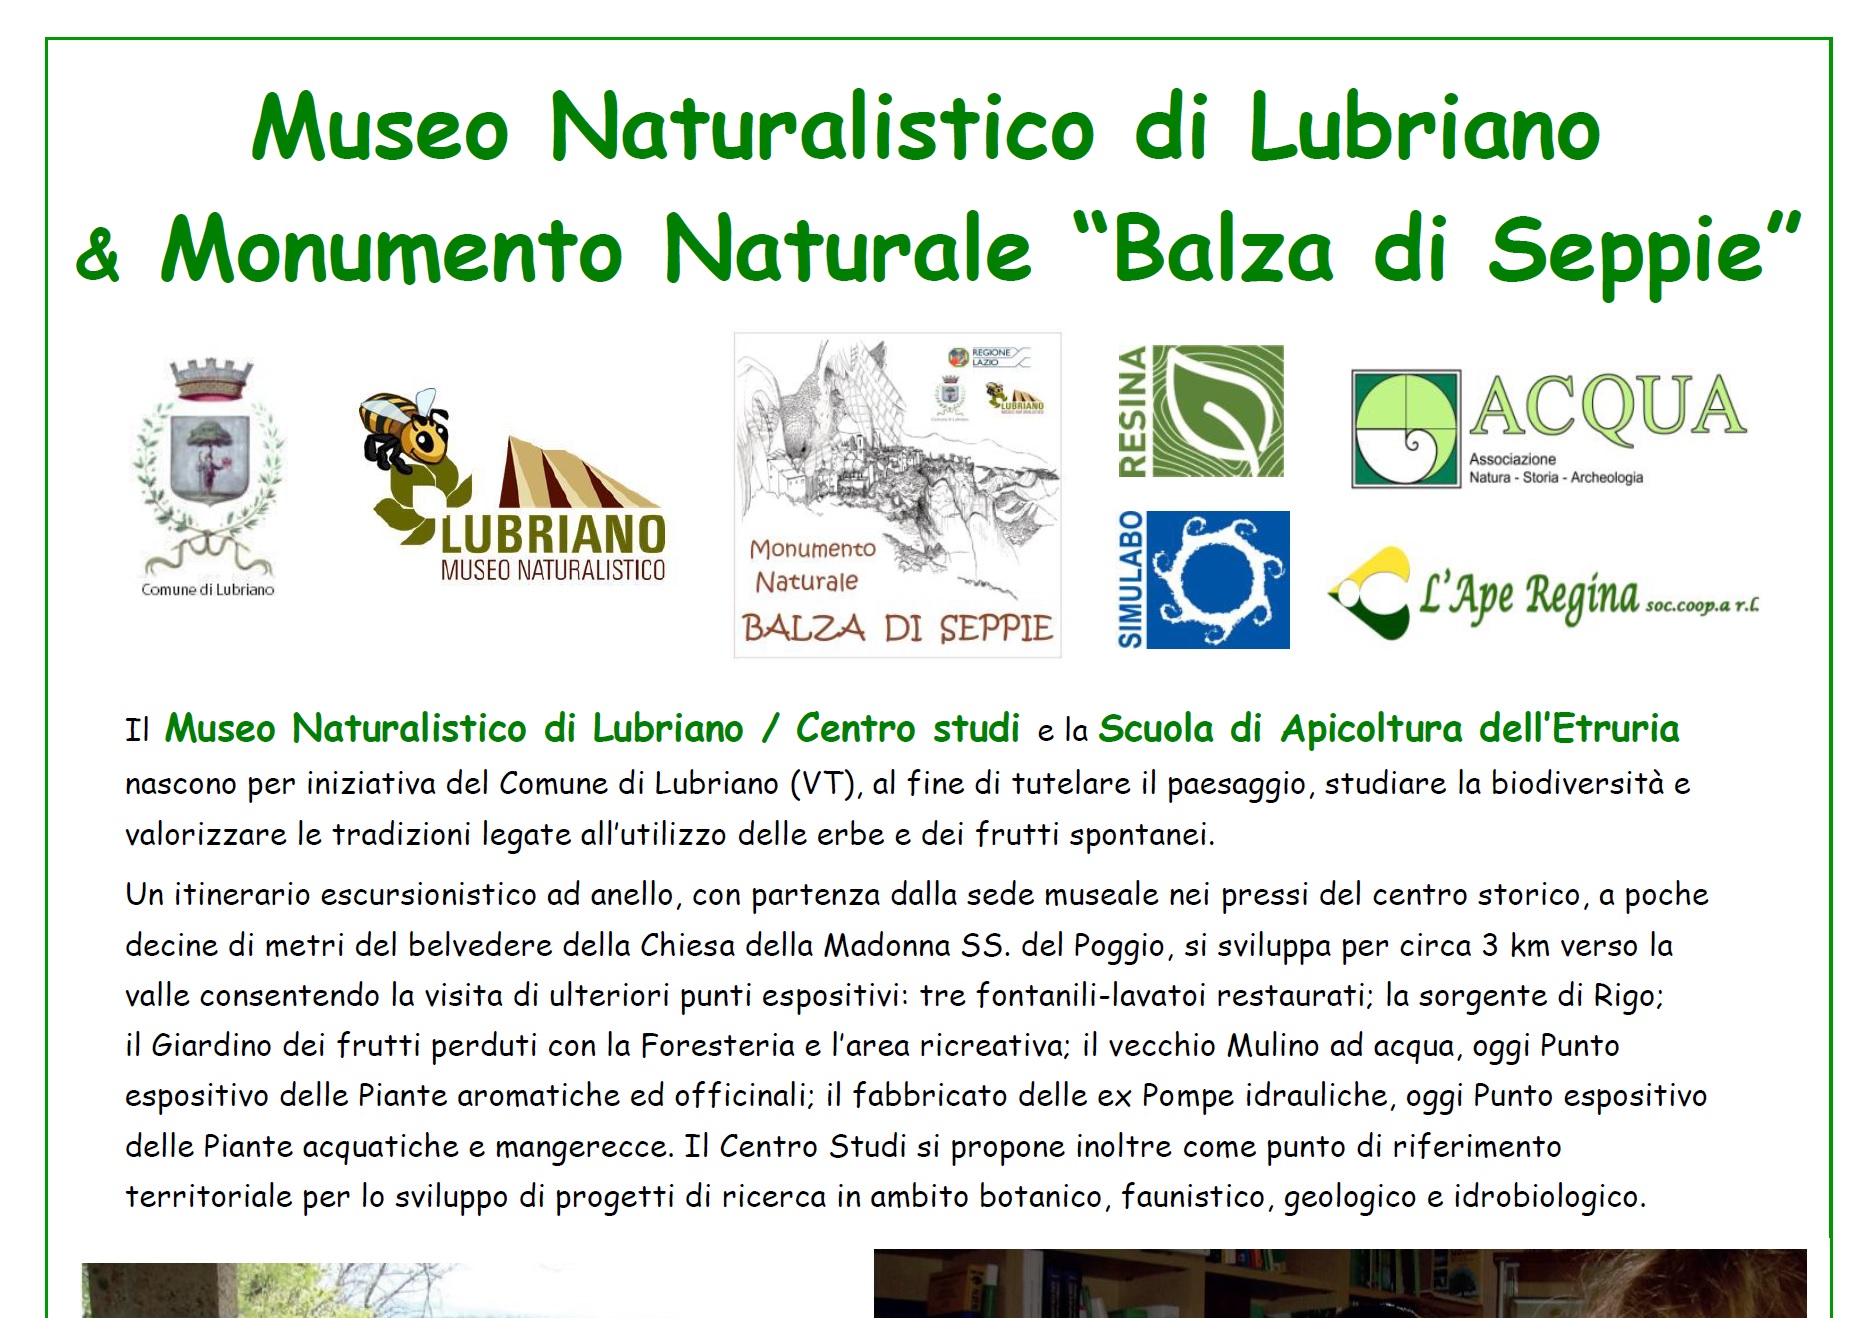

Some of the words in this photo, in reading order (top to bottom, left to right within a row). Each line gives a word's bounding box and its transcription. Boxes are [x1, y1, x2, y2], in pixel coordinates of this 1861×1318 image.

[252, 90, 508, 161] Museo
[552, 88, 1094, 161] Naturalistico
[1136, 88, 1207, 159] di
[1251, 88, 1600, 161] Lubriano
[161, 212, 622, 285] Monumento
[666, 210, 1031, 283] Naturale
[1073, 210, 1333, 282] “Balza
[1375, 210, 1446, 281] di
[1489, 210, 1801, 303] Seppie”
[972, 348, 1011, 357] REGIONE
[972, 358, 999, 367] LAZIO
[1118, 345, 1147, 478] RESINA
[1468, 372, 1748, 450] ACQUA
[1469, 452, 1557, 466] Associazione
[1470, 471, 1510, 483] Natura
[1524, 471, 1558, 483] Storia
[1571, 471, 1643, 486] Archeologia
[441, 514, 666, 554] LUBRIANO
[750, 538, 877, 560] Monumento
[442, 559, 509, 580] MUSEO
[519, 559, 665, 580] NATURALISTICO
[756, 571, 858, 593] Naturale
[1117, 510, 1144, 649] SIMULABO
[142, 584, 196, 595] Comune
[200, 583, 212, 595] di
[217, 583, 274, 595] Lubriano
[1645, 600, 1731, 616] soc.coop.a
[742, 613, 866, 641] BALZA
[885, 614, 922, 642] DI
[940, 613, 1053, 644] SEPPIE
[126, 716, 148, 741] Il
[165, 712, 275, 743] Museo
[293, 711, 526, 743] Naturalistico
[545, 711, 575, 742] di
[594, 711, 743, 742] Lubriano
[797, 711, 915, 742] Centro
[934, 711, 1019, 742] studi
[1039, 725, 1054, 741] e
[1066, 716, 1088, 741] la
[1099, 711, 1214, 742] Scuola
[1231, 711, 1261, 742] di
[1280, 711, 1462, 751] Apicoltura
[126, 778, 236, 794] nascono
[249, 777, 295, 803] per
[308, 771, 435, 794] iniziativa
[447, 769, 487, 794] del
[500, 771, 608, 795] Comune
[619, 769, 643, 794] di
[656, 769, 778, 794] Lubriano
[791, 769, 862, 801] (VT),
[873, 769, 894, 794] al
[907, 769, 964, 796] fine
[975, 769, 999, 794] di
[1012, 769, 1130, 794] tutelare
[1143, 769, 1155, 794] il
[1169, 771, 1314, 803] paesaggio,
[1325, 769, 1446, 794] studiare
[1459, 769, 1481, 794] la
[1493, 769, 1664, 794] biodiversità
[1675, 778, 1690, 794] e
[126, 820, 286, 846] valorizzare
[299, 820, 321, 845] le
[332, 820, 470, 845] tradizioni
[484, 820, 571, 854] legate
[739, 820, 807, 845] delle
[818, 820, 884, 845] erbe
[896, 829, 911, 845] e
[922, 820, 963, 845] dei
[976, 820, 1058, 847] frutti
[1070, 822, 1214, 854] spontanei.
[126, 981, 189, 1006] valle
[200, 981, 379, 1006] consentendo
[393, 981, 414, 1006] la
[425, 983, 502, 1006] visita
[514, 981, 538, 1006] di
[551, 981, 668, 1006] ulteriori
[681, 983, 751, 1015] punti
[763, 983, 907, 1015] espositivi:
[920, 985, 965, 1006] tre
[976, 981, 1205, 1008] fontanili-lavatoi
[1218, 983, 1372, 1009] restaurati;
[1387, 981, 1409, 1006] la
[1419, 985, 1547, 1015] sorgente
[1558, 981, 1582, 1006] di
[1595, 983, 1662, 1015] Rigo;
[126, 1083, 268, 1115] espositivo
[280, 1081, 348, 1106] delle
[360, 1083, 447, 1106] Piante
[458, 1081, 620, 1107] aromatiche
[631, 1081, 663, 1106] ed
[675, 1081, 813, 1109] officinali;
[828, 1081, 840, 1106] il
[853, 1081, 1006, 1108] fabbricato
[1019, 1081, 1087, 1106] delle
[1098, 1090, 1131, 1107] ex
[1144, 1083, 1234, 1115] Pompe
[1247, 1081, 1395, 1111] idrauliche,
[1407, 1083, 1462, 1115] oggi
[1475, 1083, 1552, 1106] Punto
[1565, 1083, 1706, 1115] espositivo
[126, 1132, 194, 1157] delle
[205, 1134, 293, 1157] Piante
[303, 1132, 458, 1165] acquatiche
[470, 1141, 485, 1157] e
[497, 1141, 673, 1166] mangerecce.
[685, 1132, 707, 1157] Il
[721, 1134, 817, 1157] Centro
[830, 1132, 905, 1158] Studi
[917, 1134, 939, 1157] si
[952, 1140, 1065, 1166] propone
[1078, 1132, 1171, 1157] inoltre
[1184, 1141, 1256, 1158] come
[1268, 1136, 1345, 1166] punto
[1357, 1132, 1381, 1157] di
[1394, 1132, 1561, 1159] riferimento
[126, 1182, 292, 1207] territoriale
[304, 1190, 350, 1216] per
[363, 1182, 384, 1207] lo
[396, 1182, 507, 1216] sviluppo
[520, 1182, 544, 1207] di
[557, 1184, 673, 1216] progetti
[686, 1182, 710, 1207] di
[724, 1184, 826, 1207] ricerca
[839, 1184, 860, 1207] in
[871, 1182, 968, 1208] ambito
[981, 1182, 1110, 1212] botanico,
[1122, 1182, 1273, 1212] faunistico,
[1285, 1182, 1415, 1216] geologico
[1428, 1191, 1443, 1207] e
[1456, 1182, 1645, 1216] idrobiologico.
